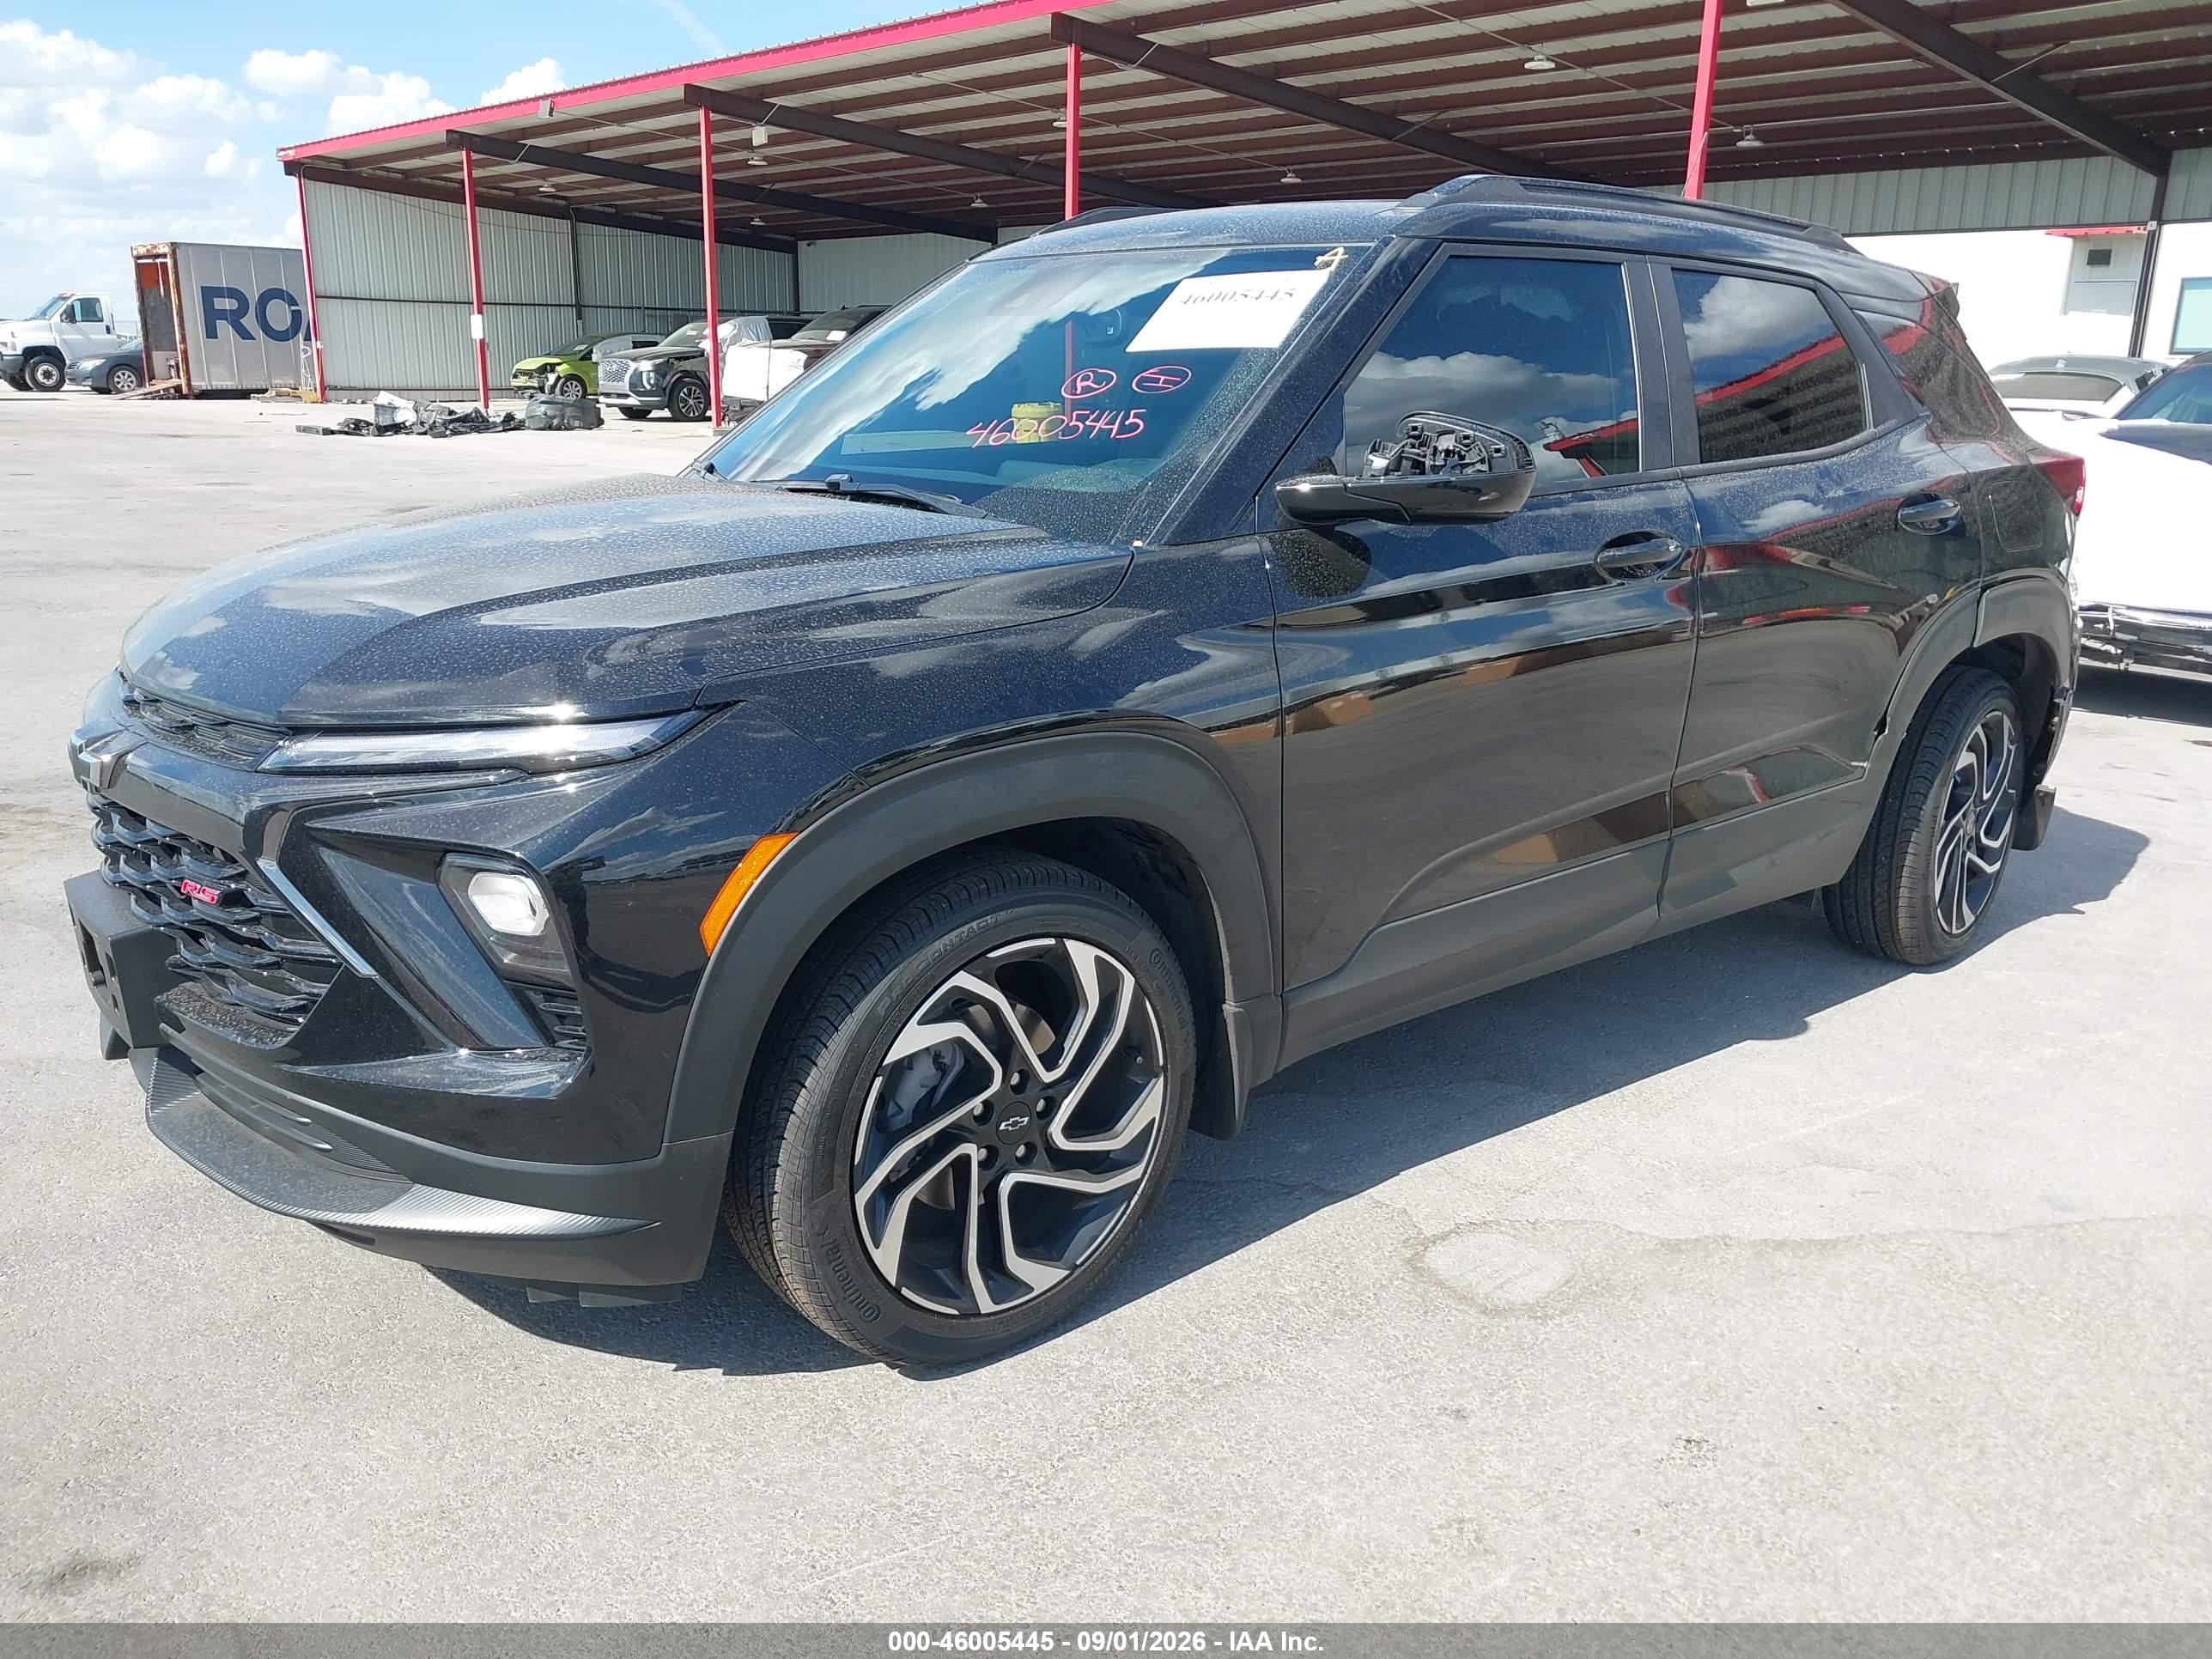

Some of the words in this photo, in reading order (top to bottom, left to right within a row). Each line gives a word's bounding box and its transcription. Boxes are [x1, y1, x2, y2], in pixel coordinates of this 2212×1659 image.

[200, 286, 312, 342] RO
[965, 409, 1147, 448] 46005445
[181, 879, 222, 904] RS
[820, 1237, 881, 1323] Continental
